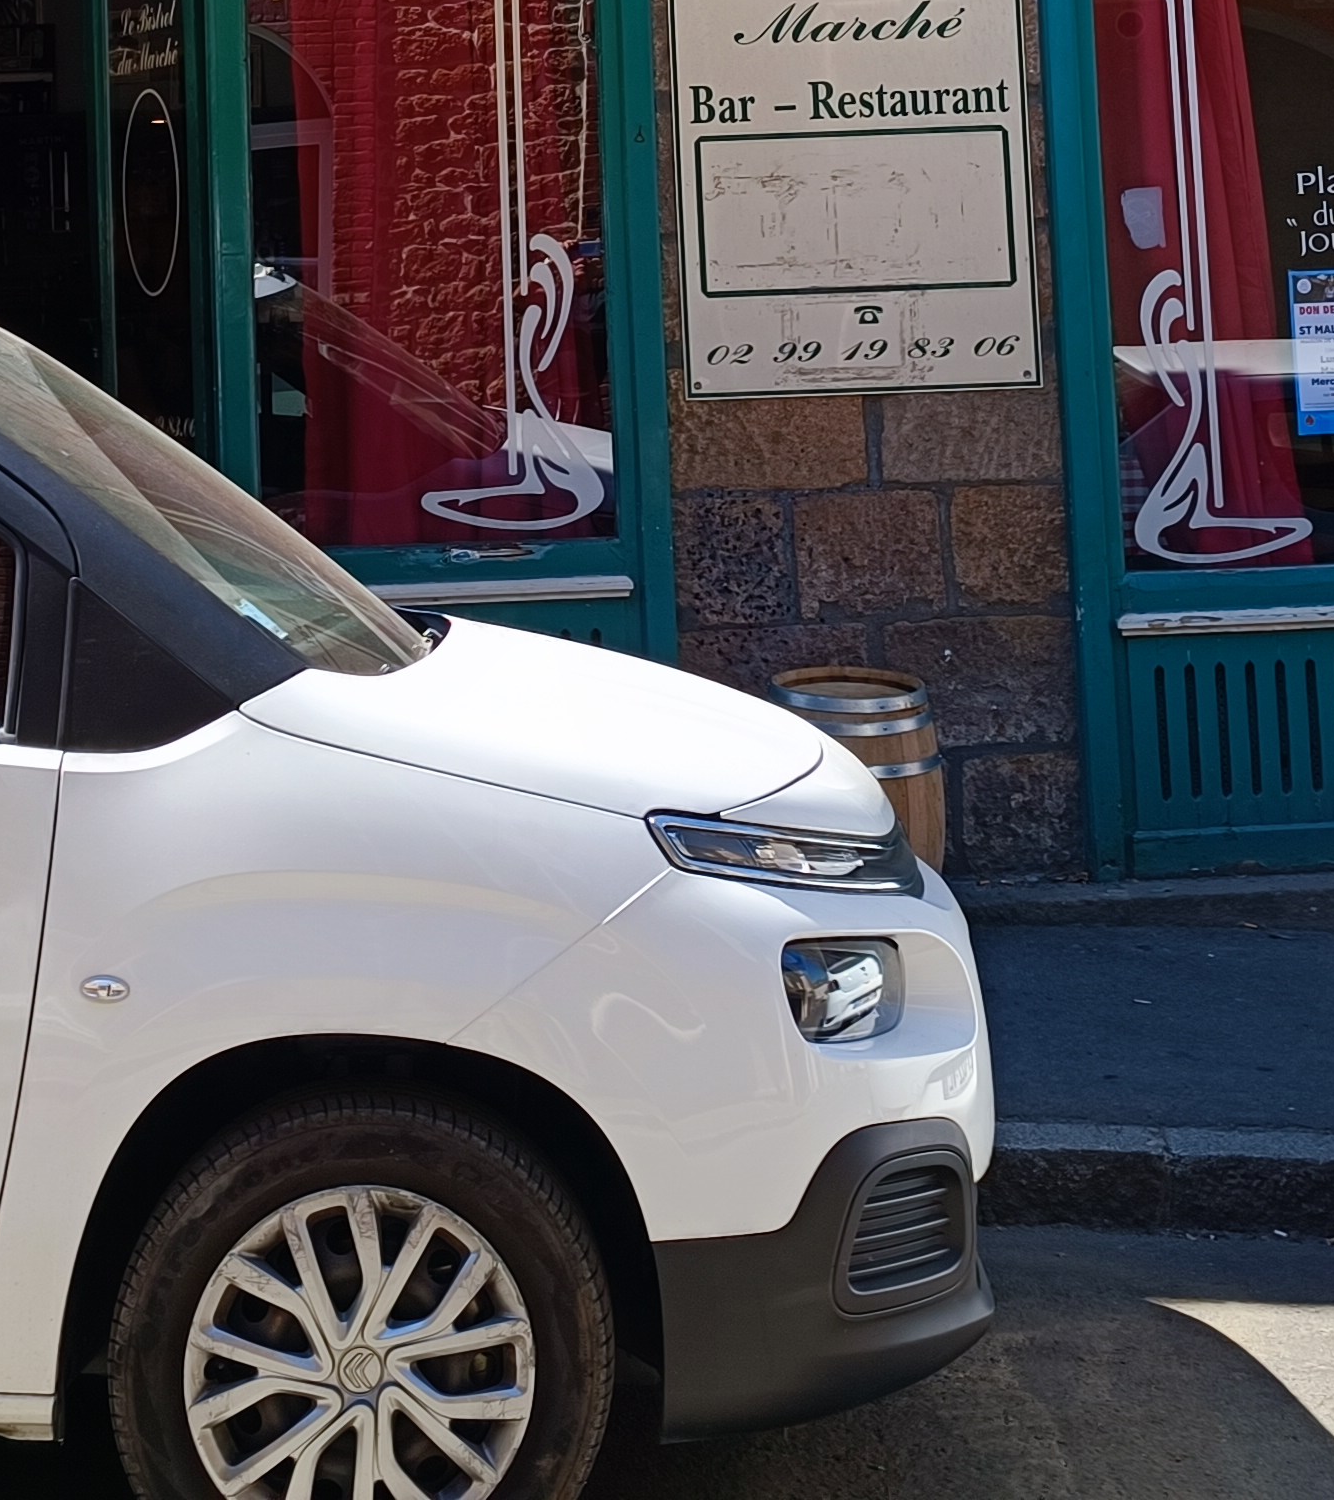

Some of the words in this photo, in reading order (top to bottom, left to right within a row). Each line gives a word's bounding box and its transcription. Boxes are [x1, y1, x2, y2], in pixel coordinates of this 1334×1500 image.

[733, 0, 965, 46] Marché
[689, 84, 755, 124] Bar
[808, 79, 1010, 120] Restaurant
[1299, 305, 1320, 315] DON
[1298, 325, 1312, 336] ST
[706, 343, 755, 365] 02
[773, 340, 822, 363] 99
[840, 339, 888, 360] 19
[907, 336, 955, 358] 83
[973, 334, 1020, 356] 06
